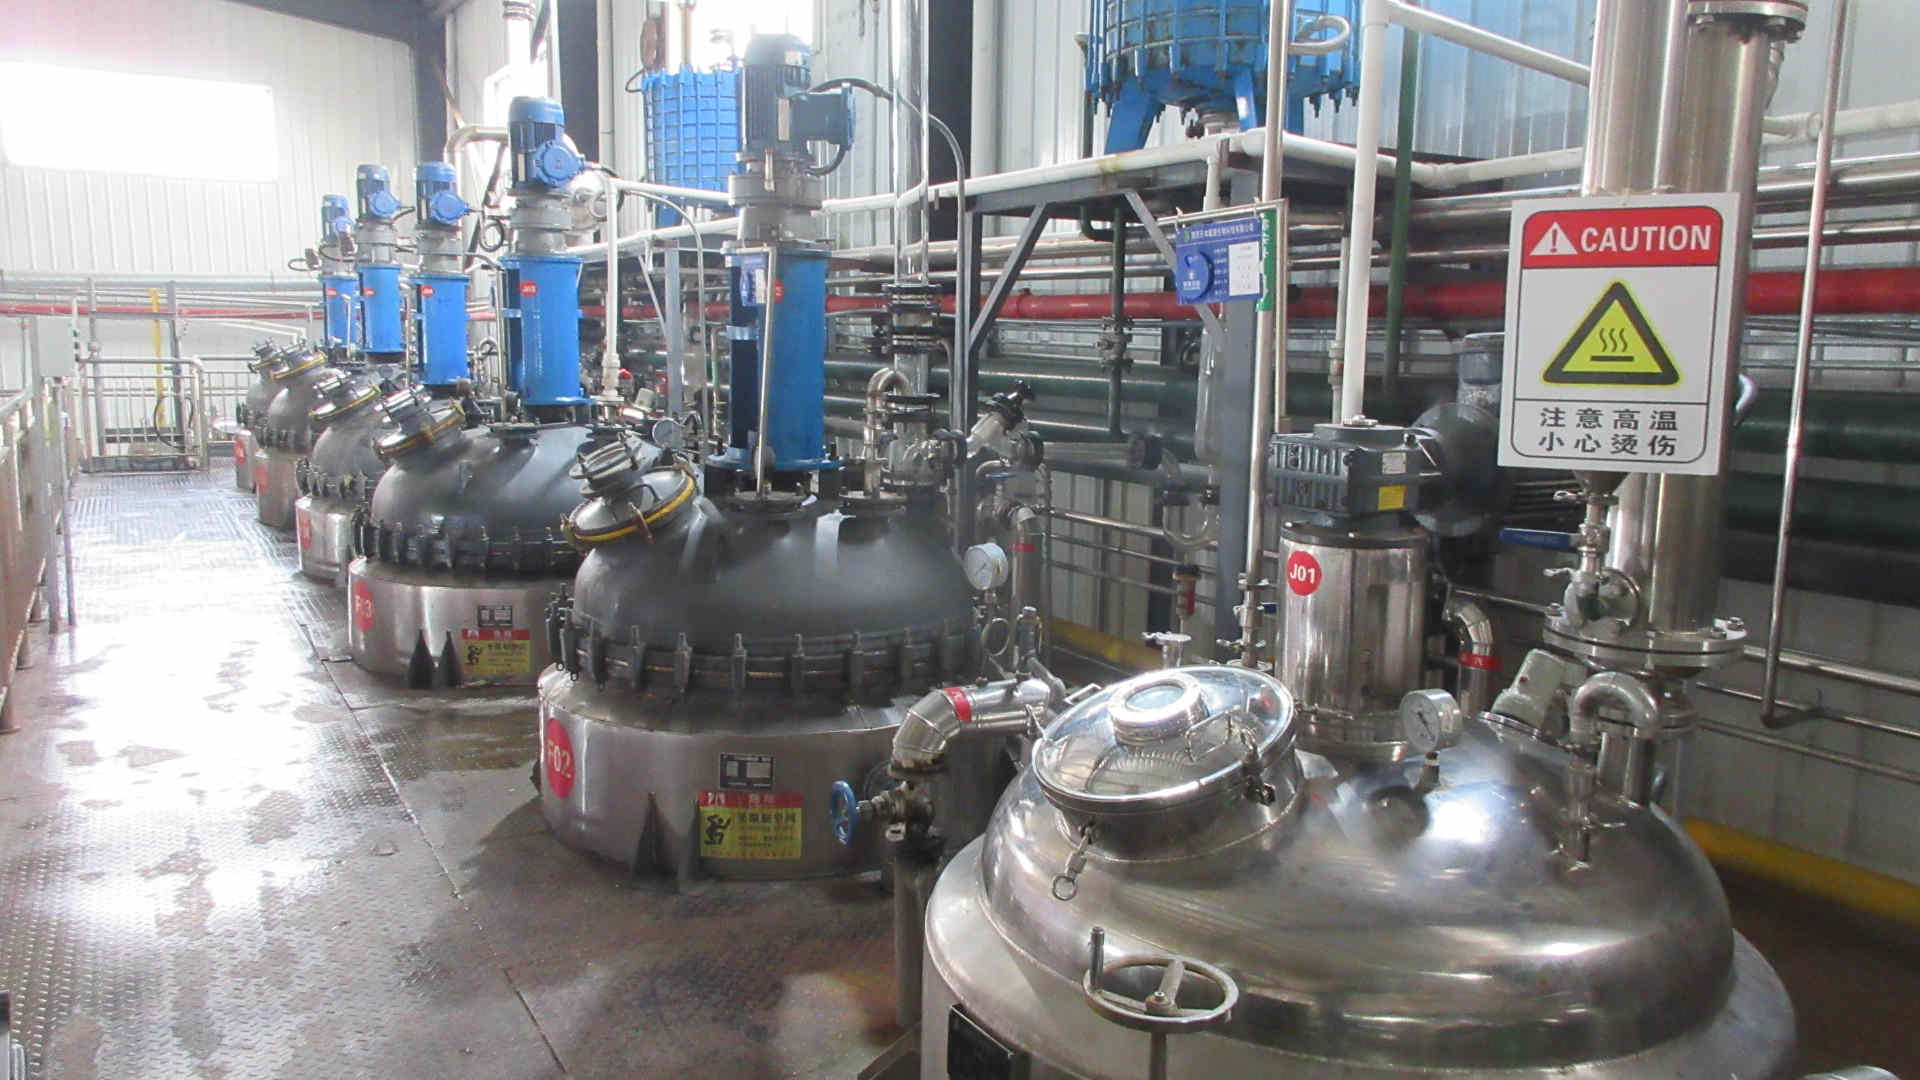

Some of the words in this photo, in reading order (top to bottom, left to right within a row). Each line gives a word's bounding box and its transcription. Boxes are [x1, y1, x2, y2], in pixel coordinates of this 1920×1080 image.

[1580, 224, 1711, 253] CAUTION
[1539, 407, 1678, 431] 注意高温
[1538, 431, 1677, 456] 小心烫伤
[1290, 563, 1315, 584] J01
[547, 738, 572, 779] F02
